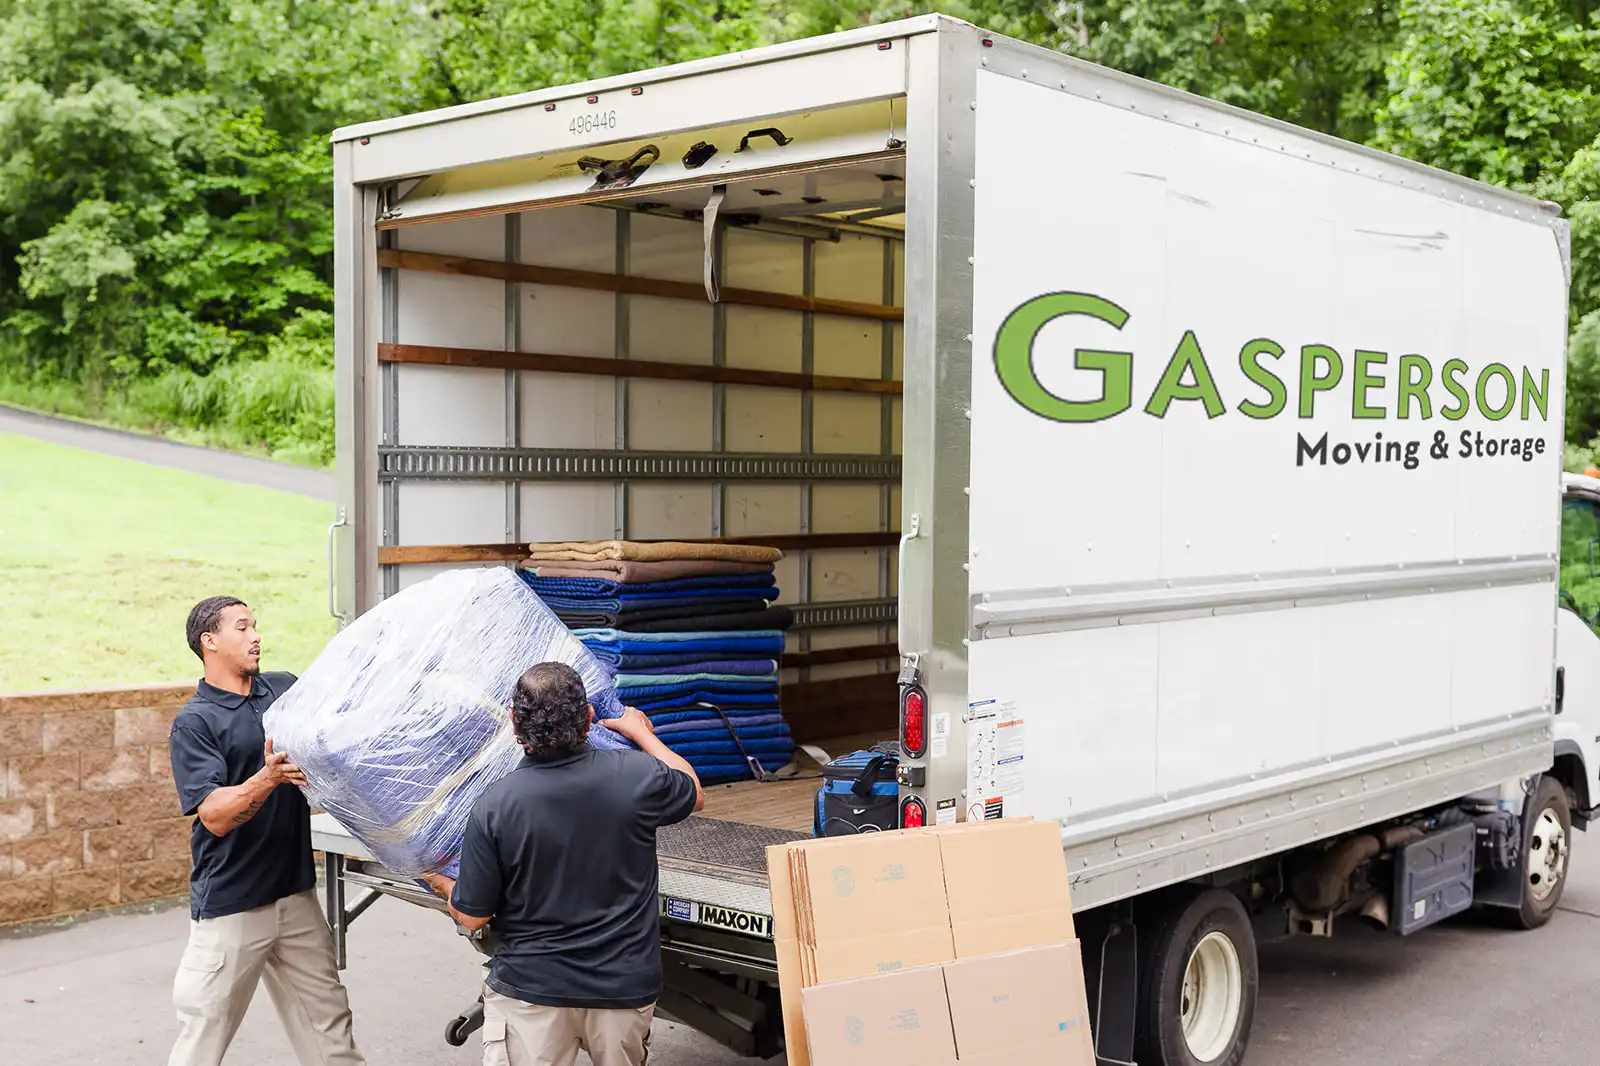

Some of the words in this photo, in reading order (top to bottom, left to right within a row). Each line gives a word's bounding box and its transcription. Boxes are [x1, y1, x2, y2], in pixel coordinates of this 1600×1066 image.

[569, 110, 616, 135] 496446
[993, 290, 1550, 423] GASPERSON
[1296, 431, 1420, 470] Moving
[1430, 431, 1449, 460] &
[1458, 429, 1546, 462] Storage
[704, 907, 763, 933] MAXON
